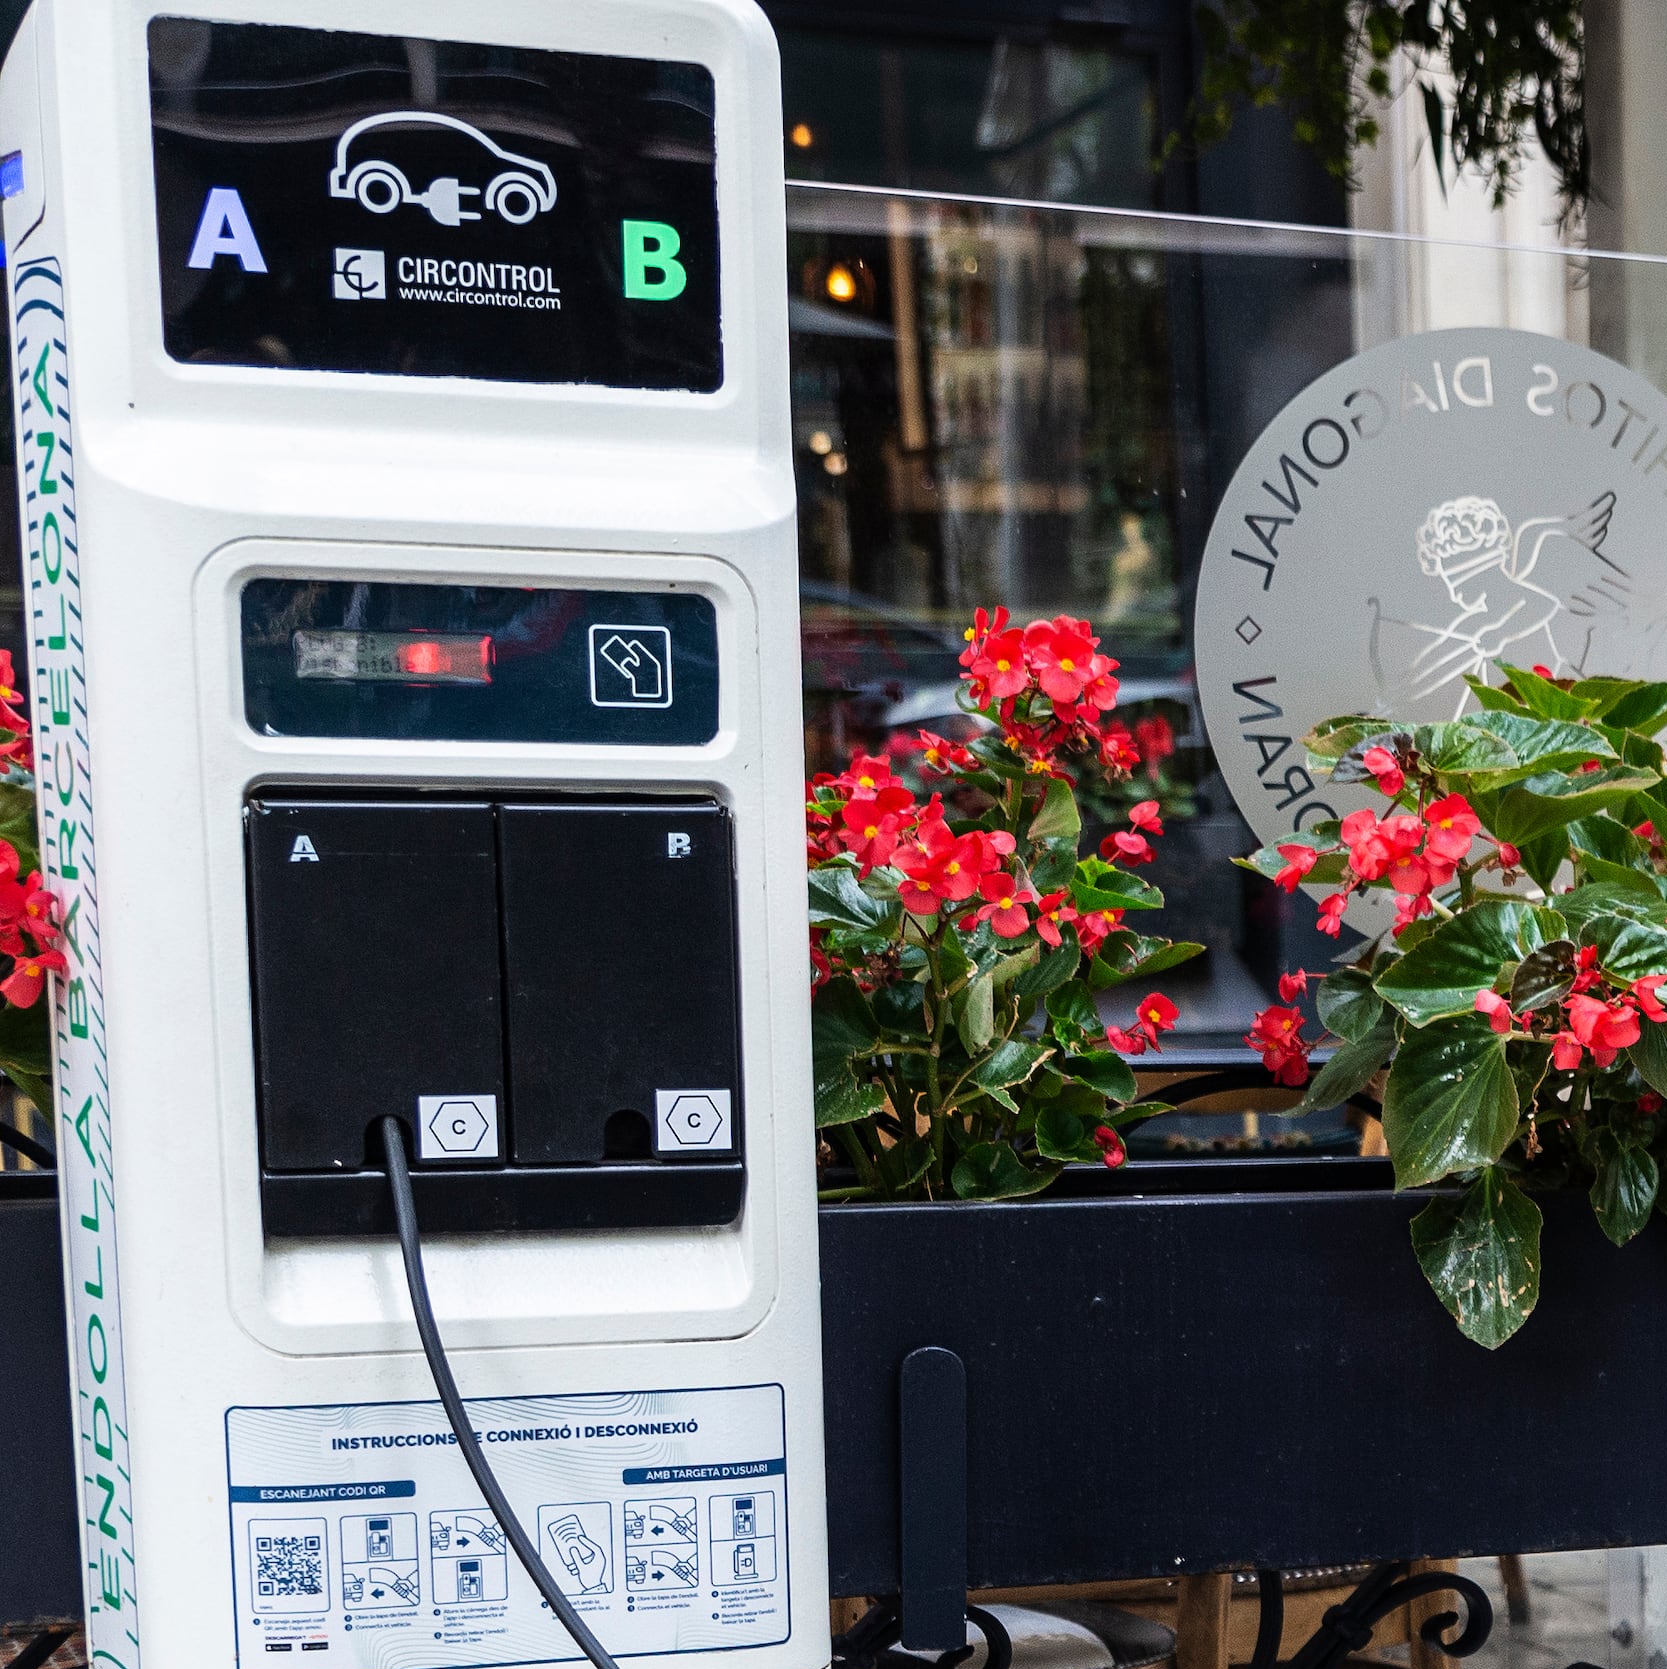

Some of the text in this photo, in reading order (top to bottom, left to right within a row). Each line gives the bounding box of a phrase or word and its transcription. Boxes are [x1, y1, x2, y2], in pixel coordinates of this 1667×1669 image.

[187, 188, 268, 273] A
[623, 219, 686, 301] B
[398, 257, 561, 294] CIRCONTROL
[399, 286, 562, 311] www.circontrol.com
[32, 341, 89, 1040] BARCELONA
[289, 835, 320, 862] A
[451, 1119, 467, 1136] C
[686, 1113, 702, 1129] C
[70, 1094, 125, 1611] ENDOLLA
[331, 1432, 457, 1451] INSTRUCCIONS
[487, 1424, 571, 1443] CONNEXIÓ
[575, 1425, 581, 1439] I
[584, 1418, 699, 1439] DESCONNEXIÓ
[645, 1463, 769, 1481] AMB TARGETA D'USUARI
[260, 1484, 387, 1500] ESCANEJANT CODI QR
